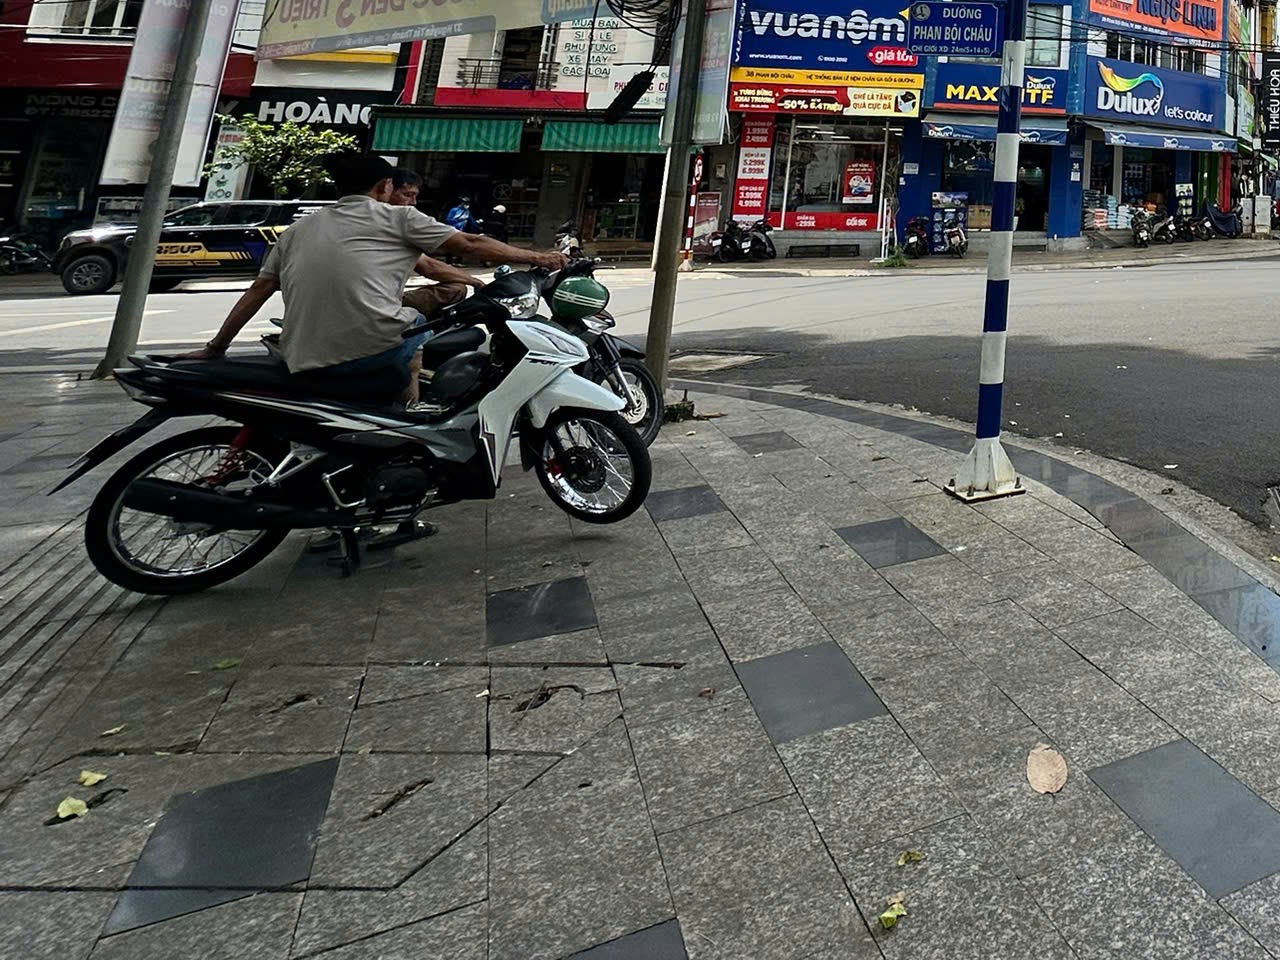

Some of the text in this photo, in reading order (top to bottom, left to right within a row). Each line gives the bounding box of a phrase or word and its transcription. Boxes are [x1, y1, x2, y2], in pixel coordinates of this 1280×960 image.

[943, 4, 982, 19] ĐƯỜNG
[1183, 0, 1217, 31] LINH
[913, 23, 992, 44] PHAN BỘI CHÂU
[946, 84, 1054, 105] MAXITE
[1097, 86, 1157, 116] Dulux
[1184, 109, 1214, 123] colour
